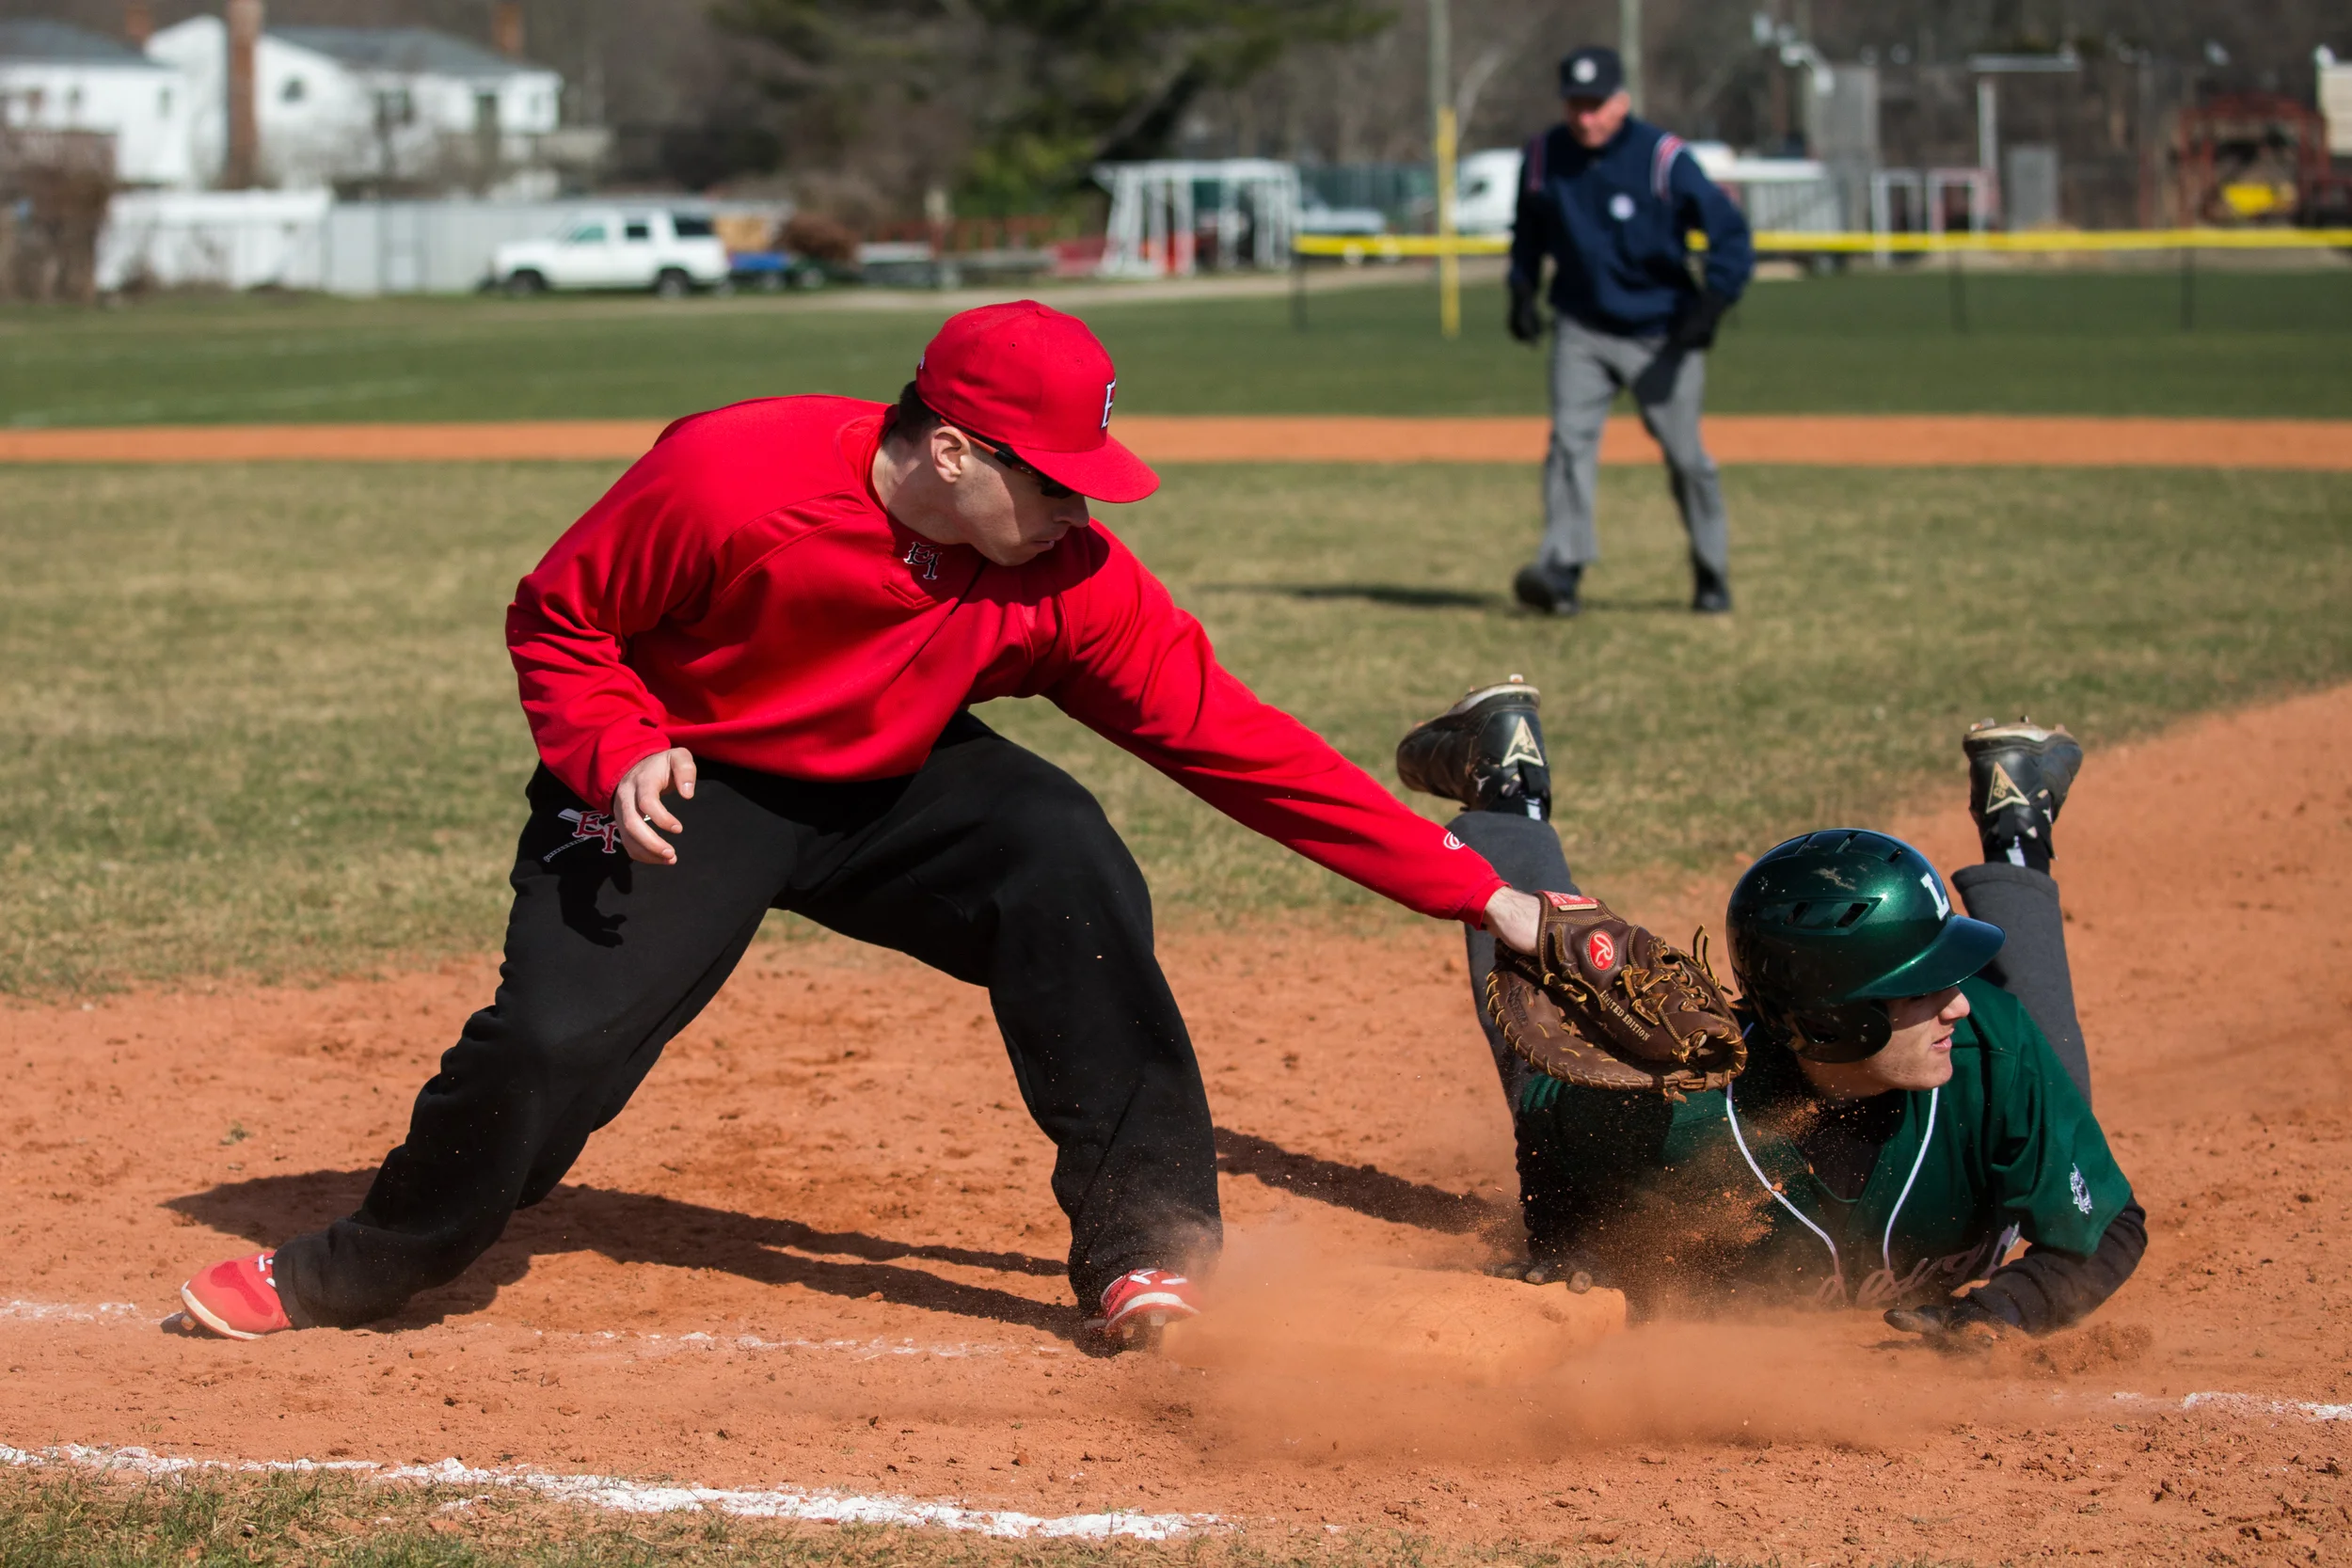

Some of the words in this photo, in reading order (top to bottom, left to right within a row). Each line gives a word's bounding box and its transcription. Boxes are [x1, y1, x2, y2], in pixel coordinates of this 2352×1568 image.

[1920, 872, 1950, 922] L
[1599, 990, 1625, 1017] LIMITED
[1622, 1014, 1651, 1041] EDITION
